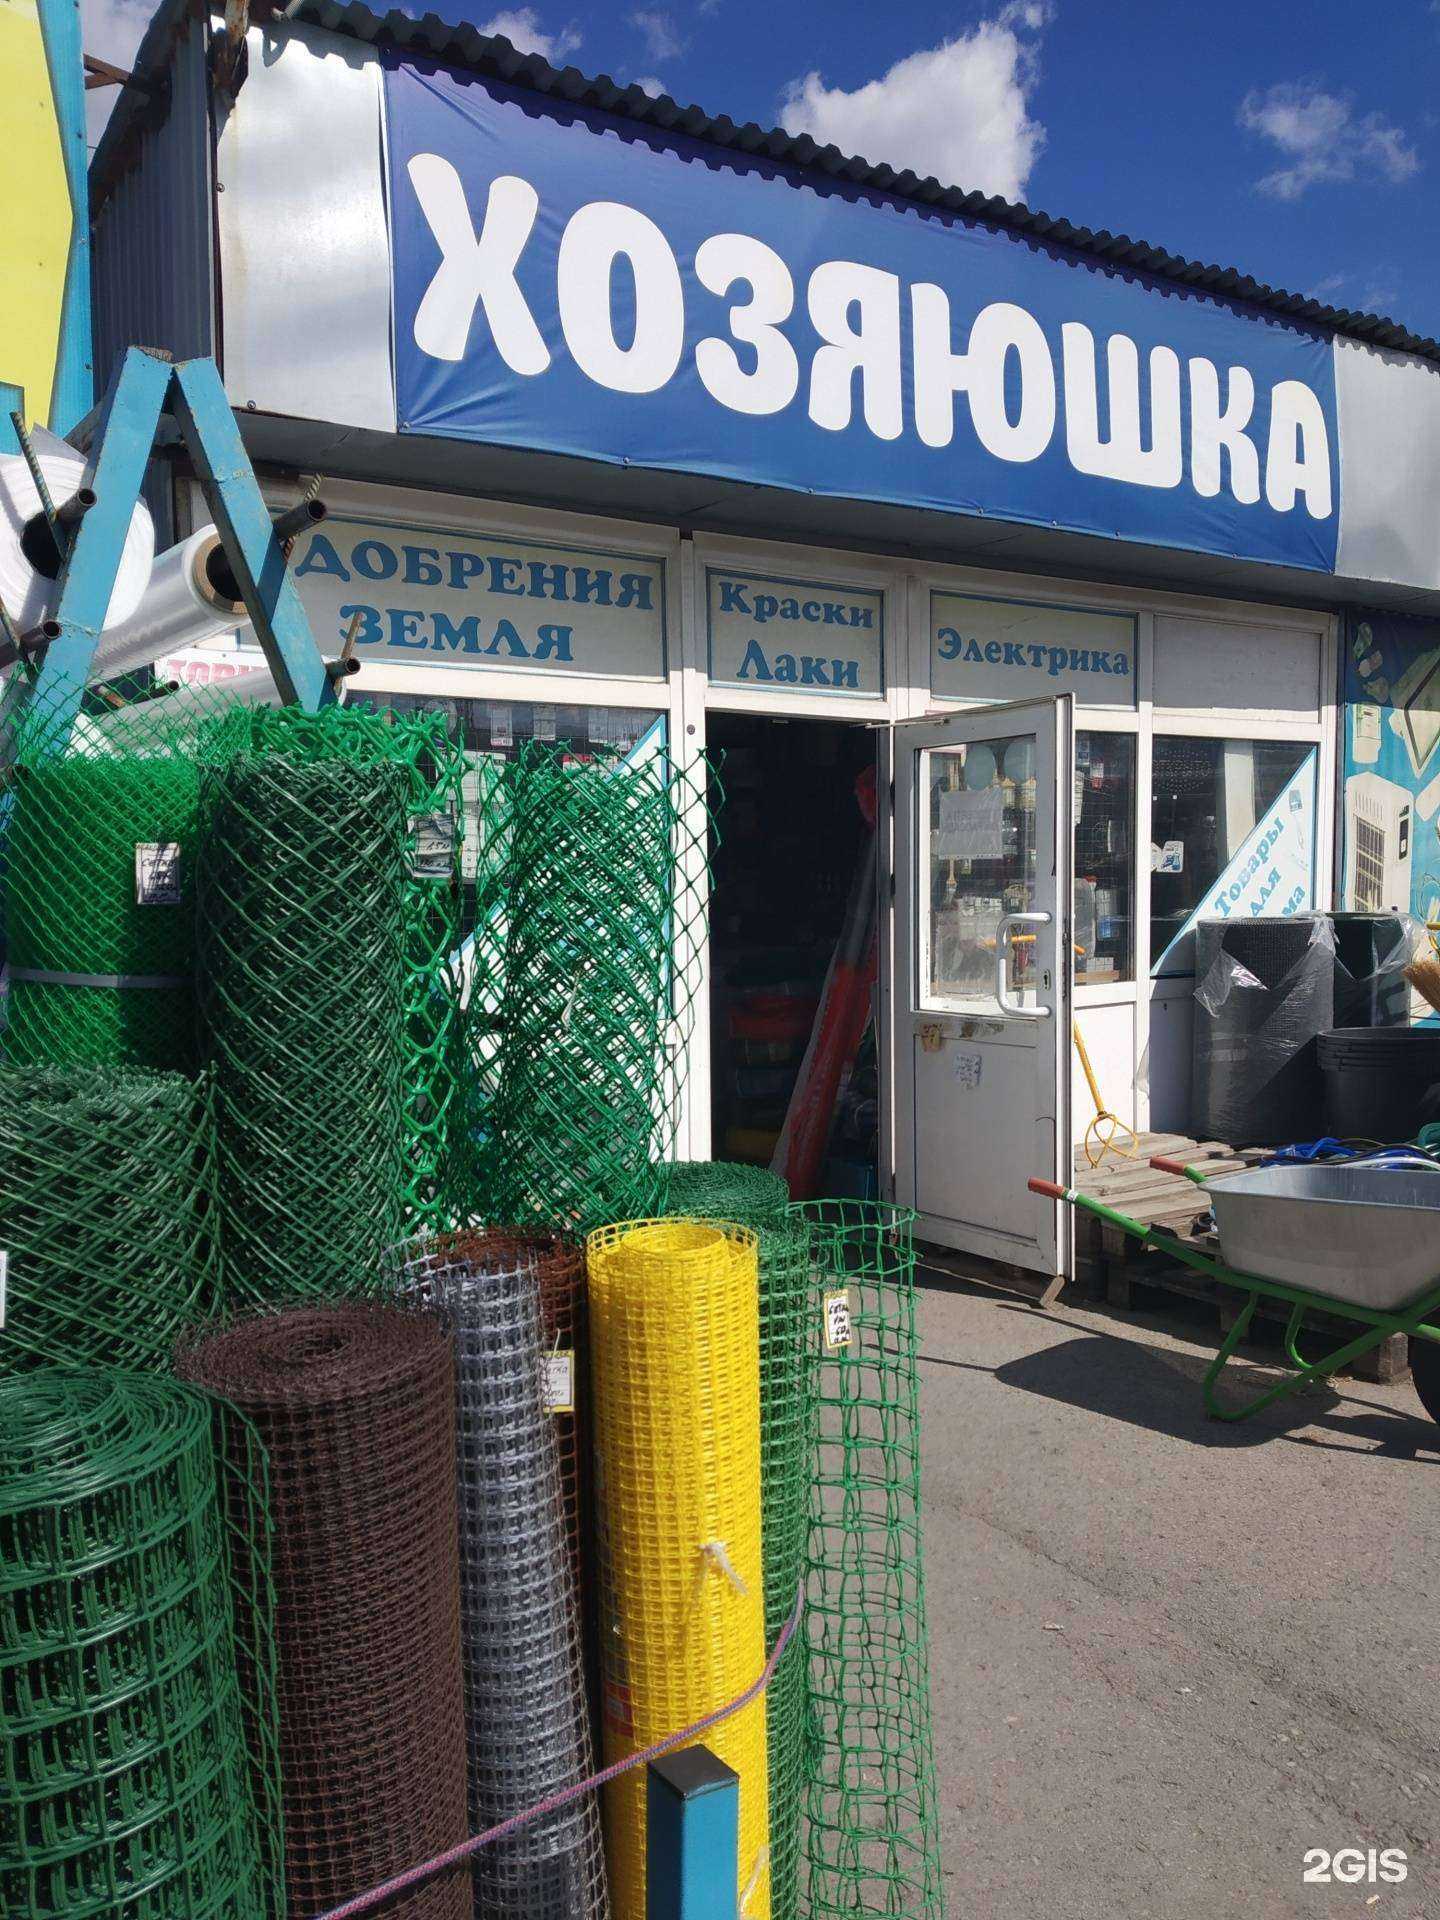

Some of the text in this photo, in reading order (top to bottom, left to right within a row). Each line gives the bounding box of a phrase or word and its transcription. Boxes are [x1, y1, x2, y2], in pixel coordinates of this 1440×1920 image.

[406, 153, 1334, 521] ХОЗЯЮШКА
[294, 534, 654, 610] ДОБРЕНИЯ
[339, 604, 574, 662] ЗЕМЛЯ
[719, 581, 874, 628] Краски
[736, 639, 860, 689] Лаки
[937, 627, 1130, 677] Электрика
[1215, 817, 1284, 917] Товары
